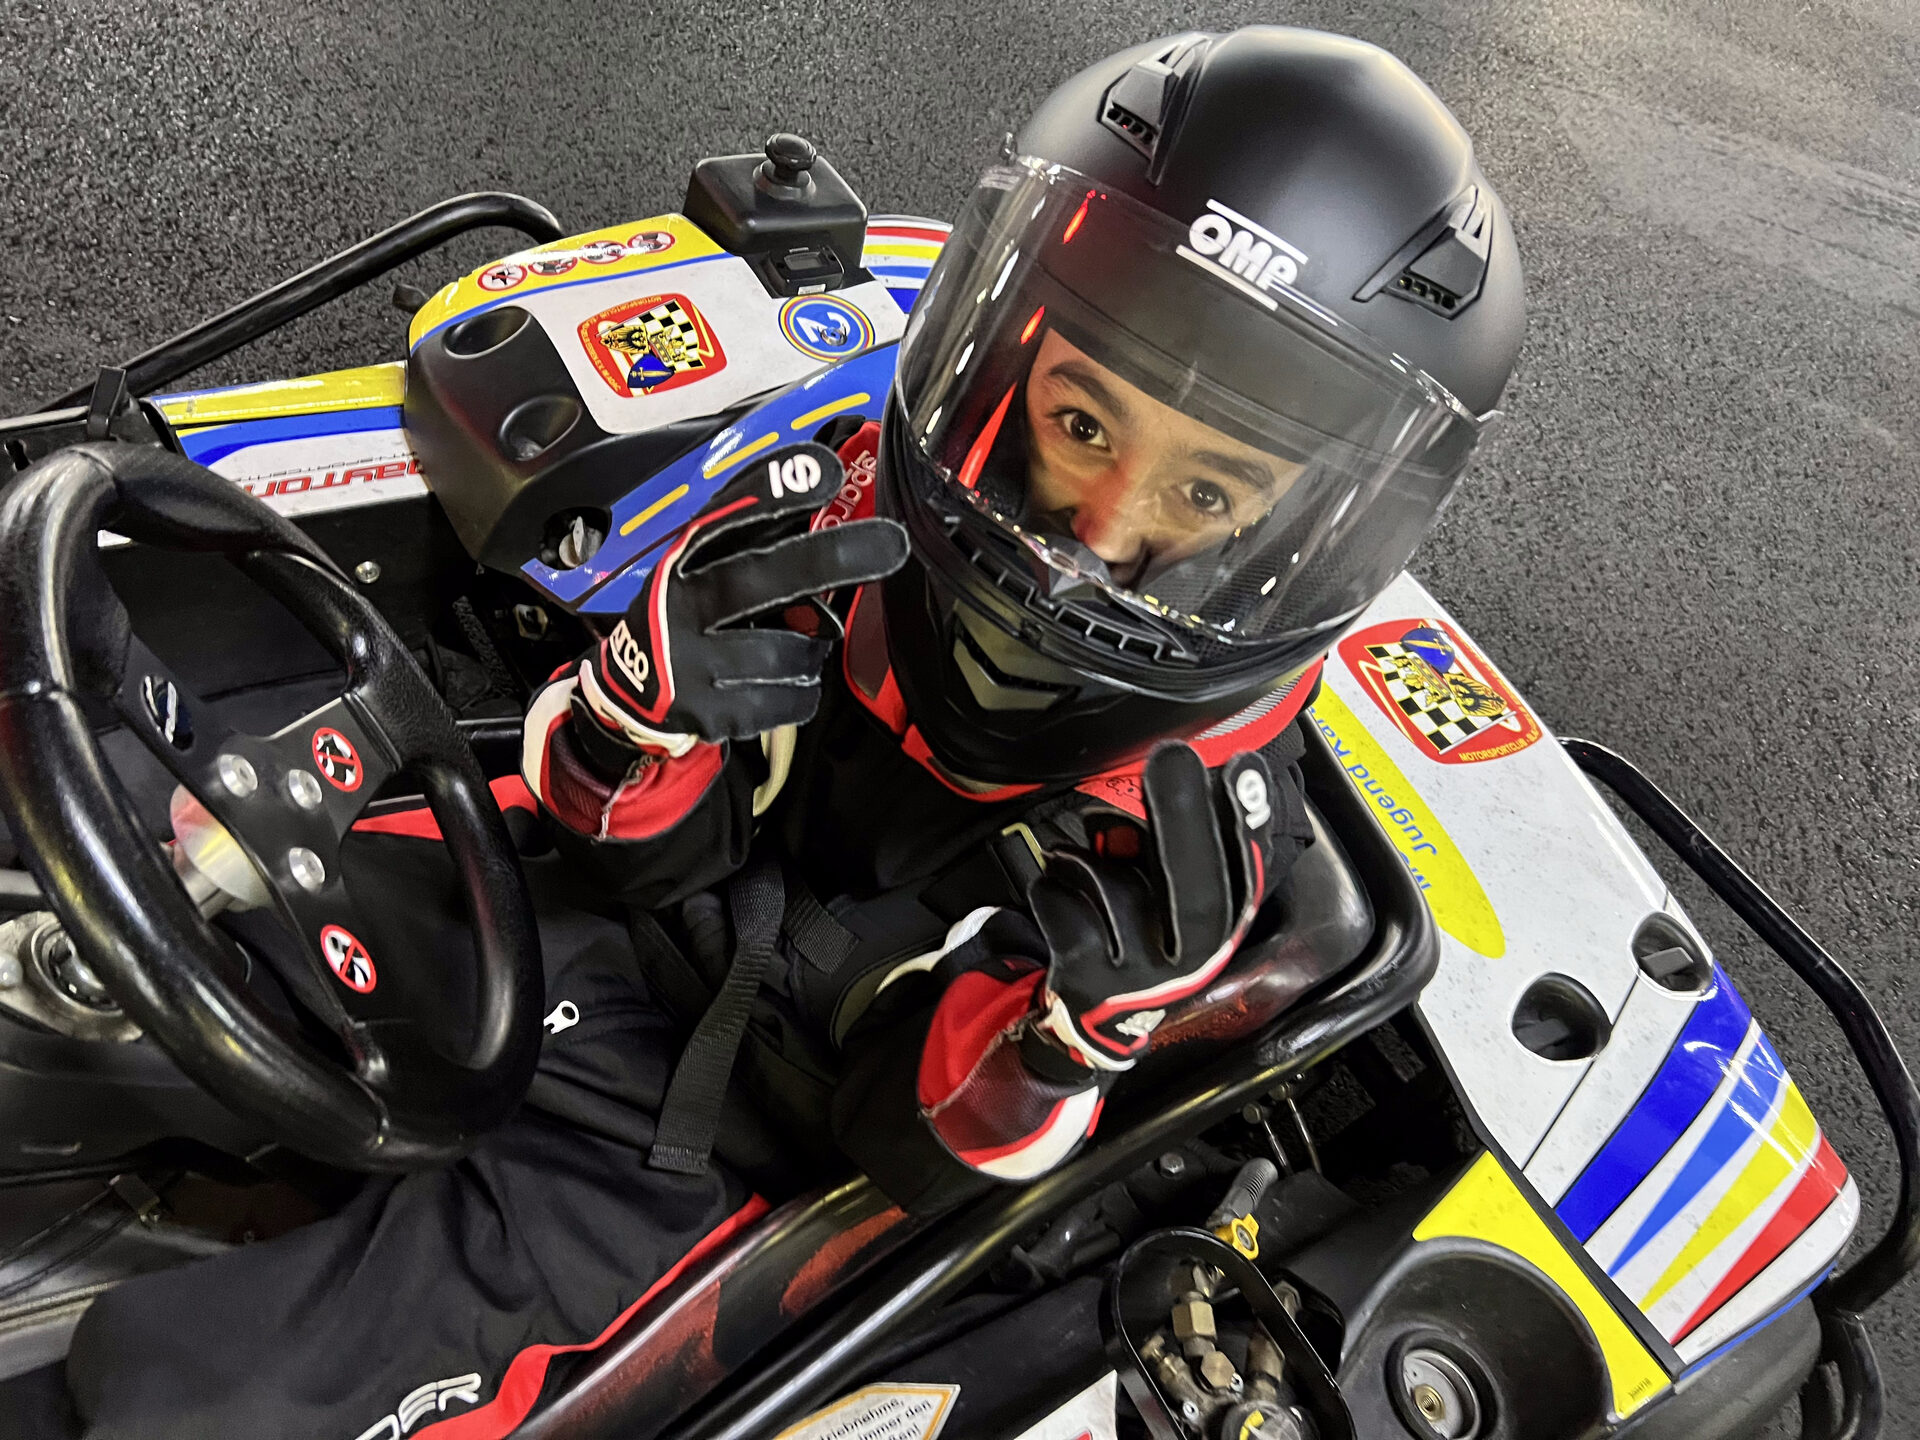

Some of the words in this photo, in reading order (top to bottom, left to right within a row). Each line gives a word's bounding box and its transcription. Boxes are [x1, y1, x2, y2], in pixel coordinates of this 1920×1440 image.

[1187, 212, 1299, 292] OMP
[1458, 737, 1528, 761] MOTORSPORTCLUB
[1346, 762, 1438, 856] Jugend
